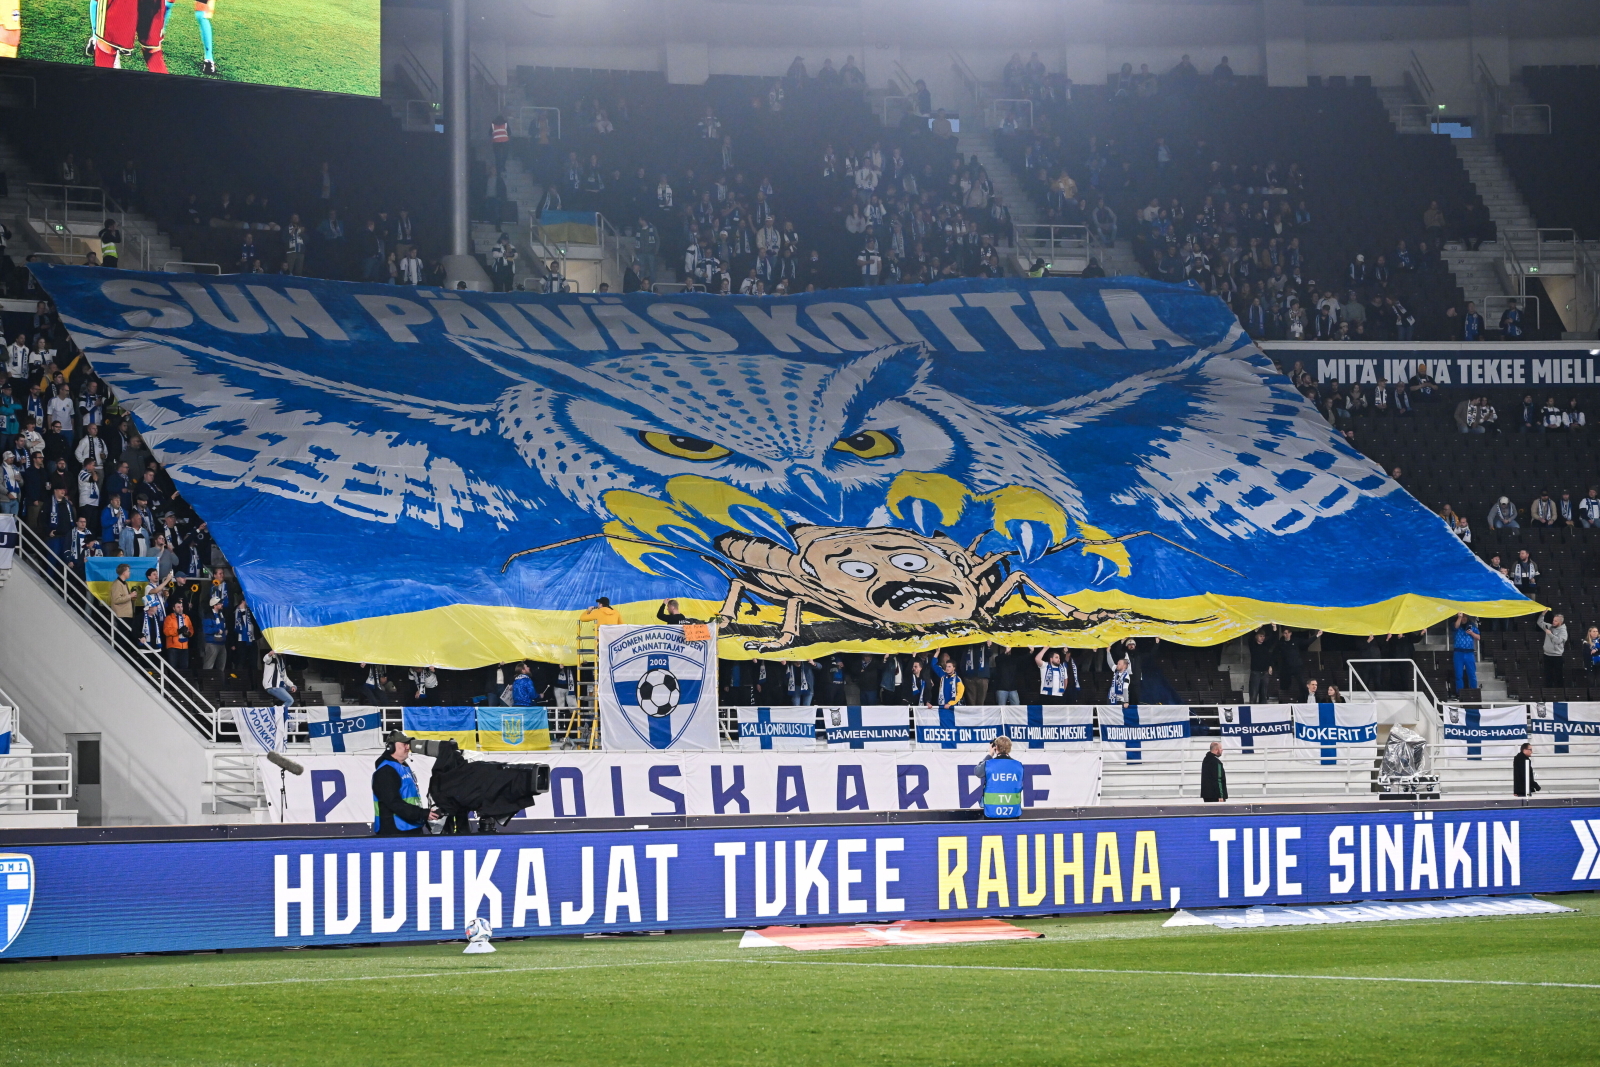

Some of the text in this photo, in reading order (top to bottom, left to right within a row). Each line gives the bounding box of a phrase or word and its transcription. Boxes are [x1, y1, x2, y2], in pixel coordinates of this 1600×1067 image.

[101, 279, 1196, 353] SUN PÄIVÄS KOITTAA
[1317, 359, 1377, 384] MITÄ
[1457, 359, 1526, 384] TEKEE
[613, 635, 643, 653] SUOMEN
[632, 642, 685, 654] KANNATTAJAT
[321, 717, 366, 736] JIPPO
[1010, 726, 1026, 740] EAST
[1221, 723, 1291, 734] LAPSIKAARTI
[1444, 727, 1527, 737] POHJOIS-HAAGA
[827, 729, 909, 741] HÄMEENLINNA
[923, 727, 997, 742] GOSSET ON TOUR
[1298, 728, 1361, 741] JOKERIT
[991, 773, 1018, 782] UEFA
[998, 794, 1012, 803] TV
[995, 806, 1014, 816] 027
[273, 811, 1521, 937] HUUHKAJAT TUKEE RAUHAA, TUE SINÄKIN
